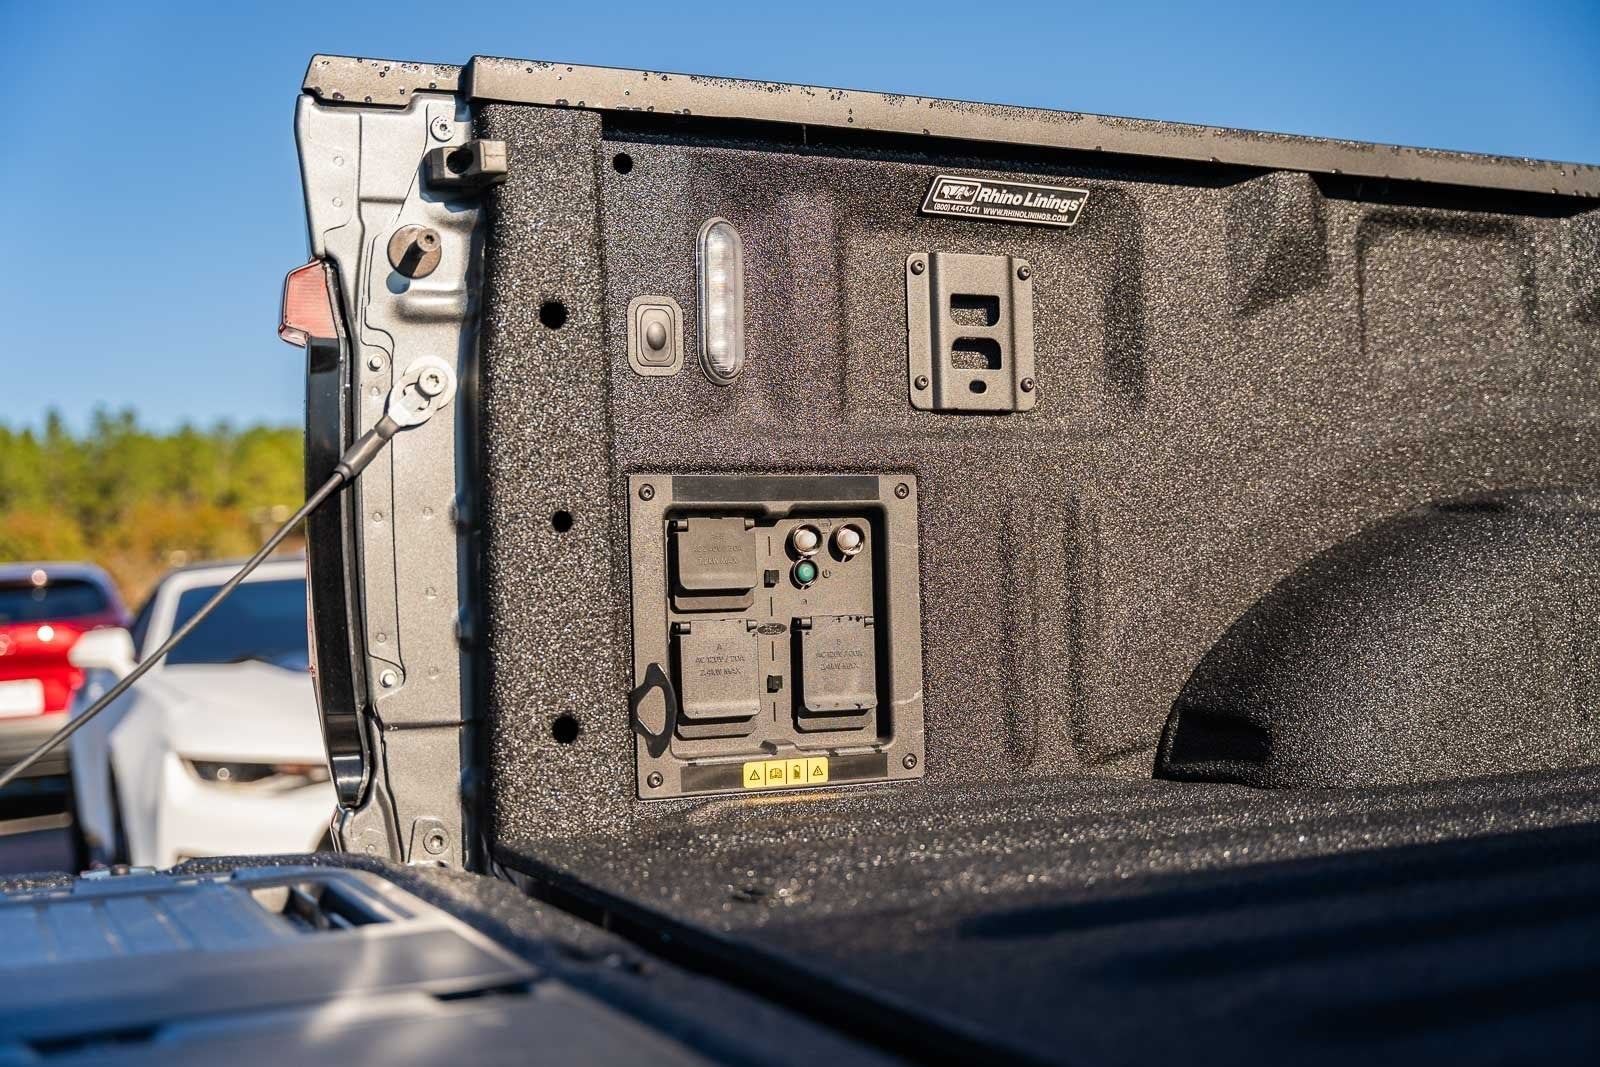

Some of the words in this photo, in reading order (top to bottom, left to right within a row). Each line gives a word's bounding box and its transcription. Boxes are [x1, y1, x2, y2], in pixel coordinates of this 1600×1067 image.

[977, 187, 1023, 205] Rhino
[1023, 191, 1080, 213] Linings
[934, 203, 951, 212] (800)
[951, 204, 980, 214] 447-1471
[983, 206, 1069, 222] WWW.RHINOLININGS.COM
